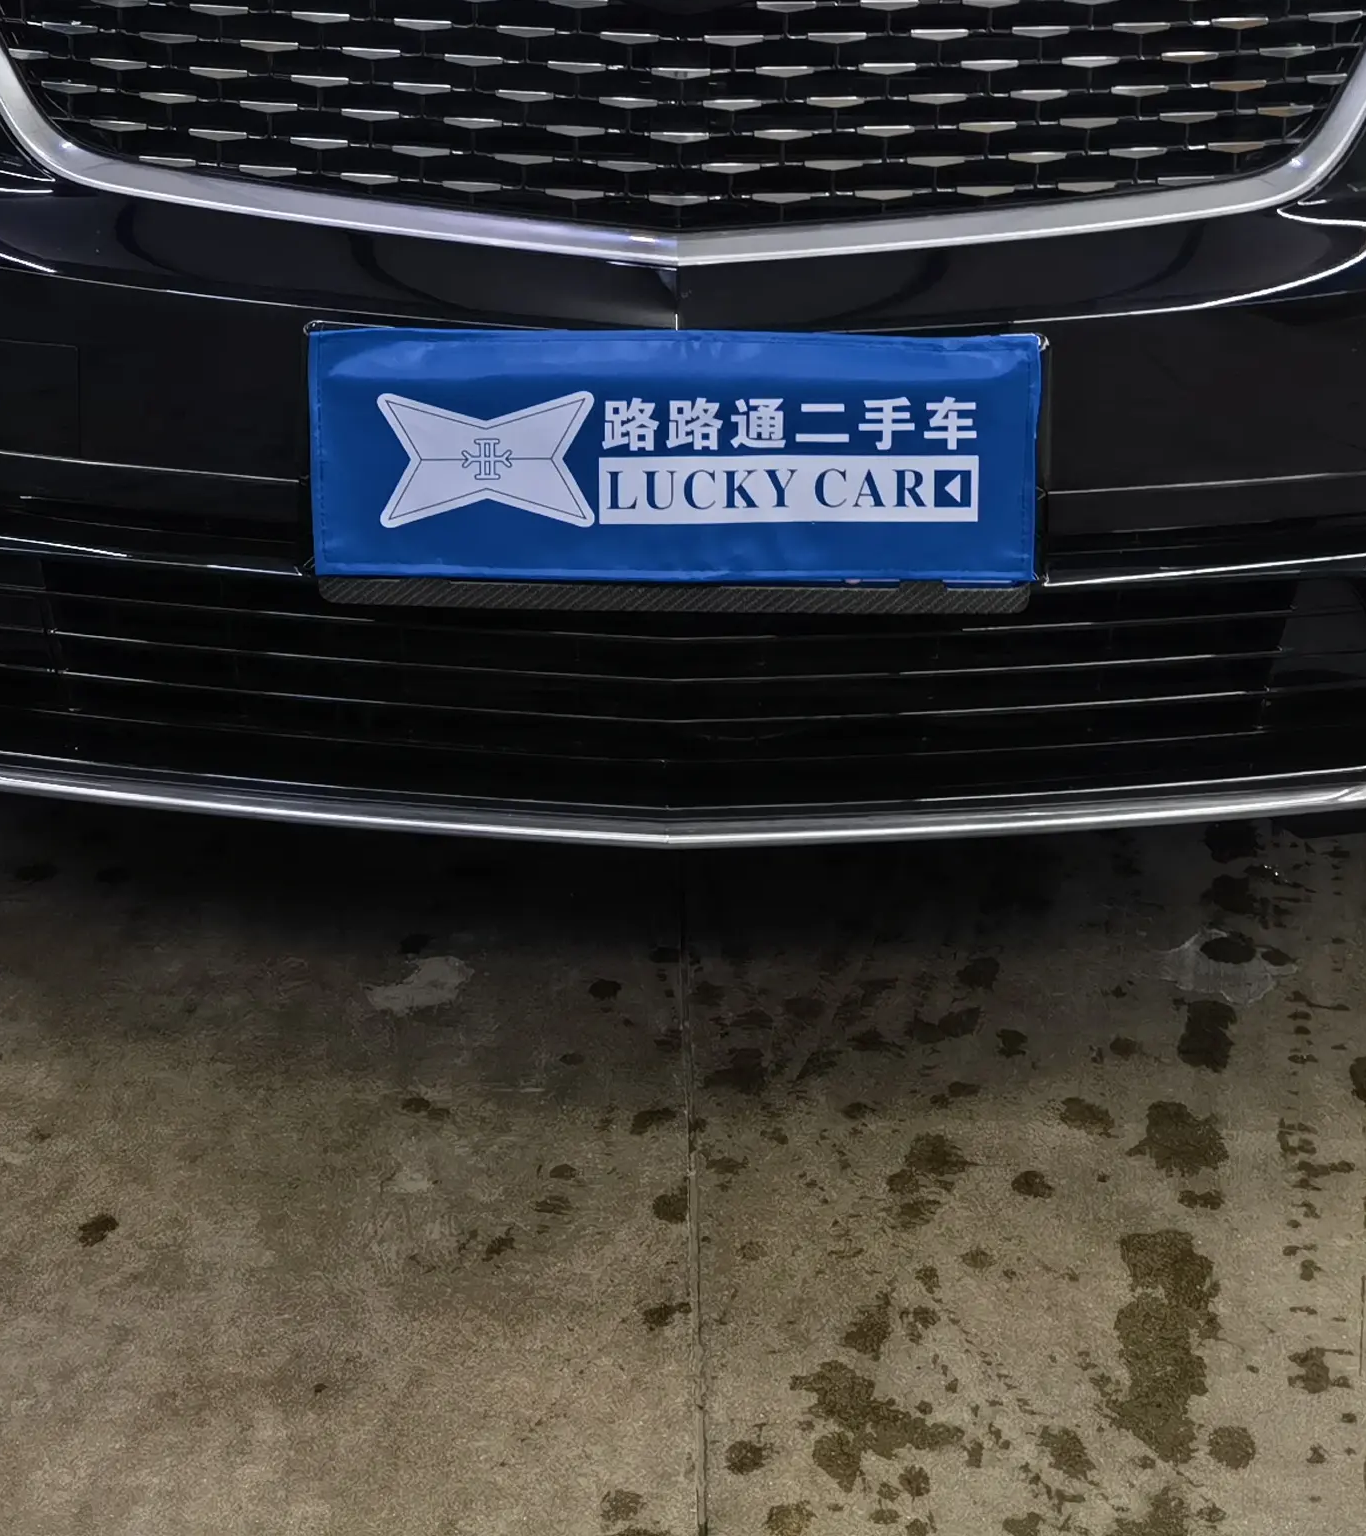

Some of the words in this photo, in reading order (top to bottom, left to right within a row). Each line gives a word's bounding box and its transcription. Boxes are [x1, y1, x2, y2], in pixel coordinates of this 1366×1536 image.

[602, 396, 978, 451] 路路通二手车
[605, 468, 798, 510] LUCKY
[814, 468, 928, 510] CAR
